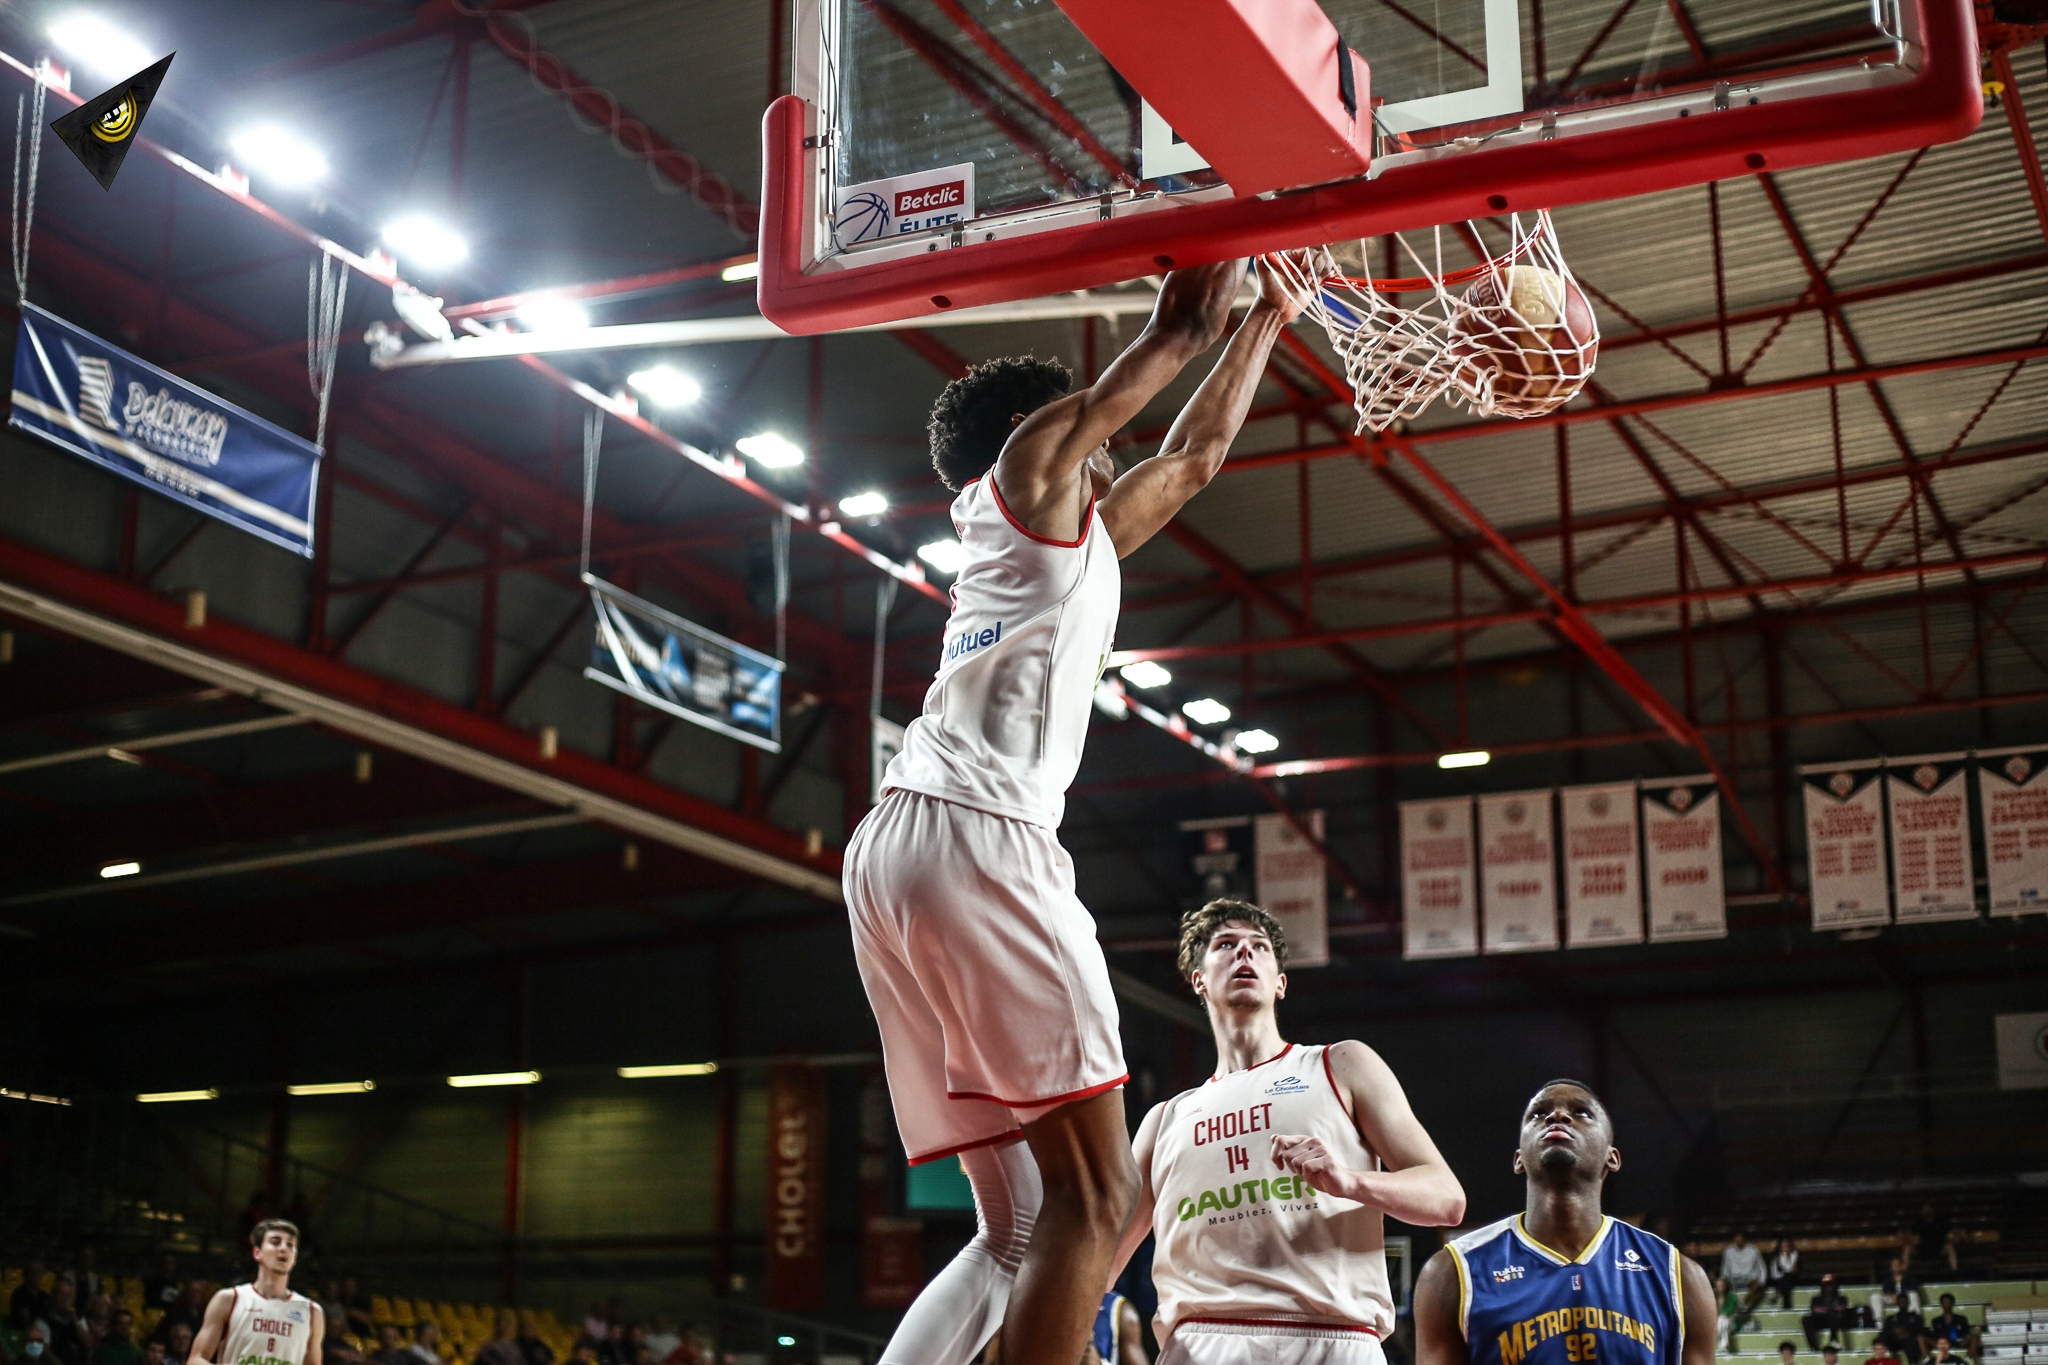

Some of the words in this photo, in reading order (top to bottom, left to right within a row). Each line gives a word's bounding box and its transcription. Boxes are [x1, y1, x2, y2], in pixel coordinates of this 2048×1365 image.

[900, 187, 960, 212] Betclic
[1194, 1102, 1273, 1146] CHOLET
[1224, 1144, 1250, 1174] 14
[1279, 1202, 1319, 1212] Vivez
[1492, 1263, 1525, 1277] rukka
[252, 1318, 294, 1338] CHOLET
[1498, 1306, 1656, 1365] METROPOLITANS
[1565, 1332, 1597, 1362] 92
